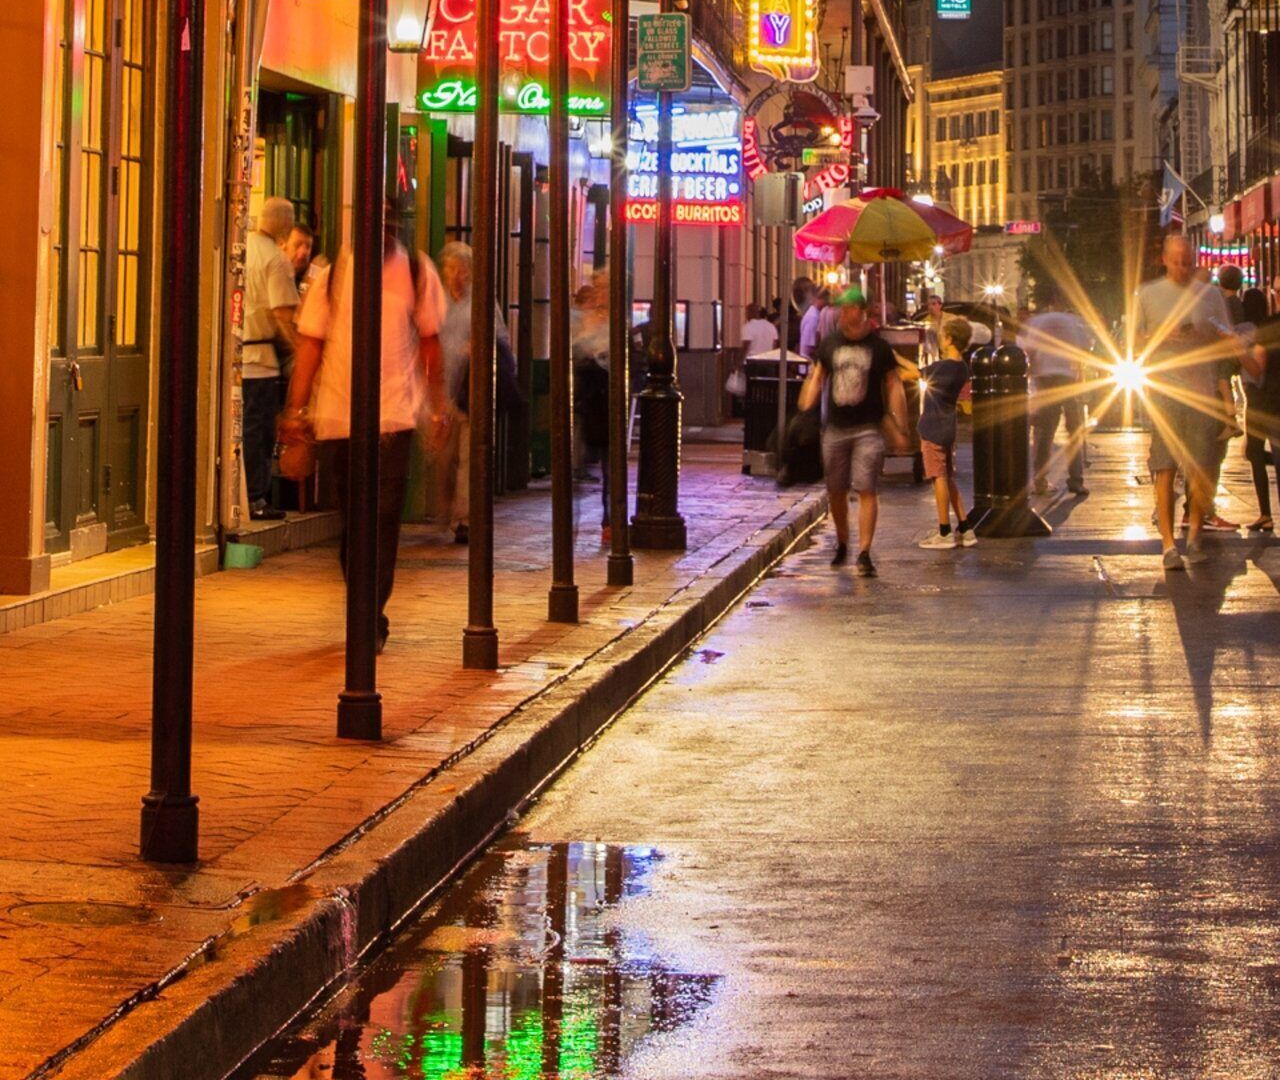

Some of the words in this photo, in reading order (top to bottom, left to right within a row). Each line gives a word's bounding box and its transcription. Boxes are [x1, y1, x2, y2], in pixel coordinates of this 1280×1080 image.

[426, 30, 605, 62] FATORY
[628, 175, 681, 199] CRAT
[684, 176, 727, 200] BEER
[676, 204, 740, 222] BURRITOS
